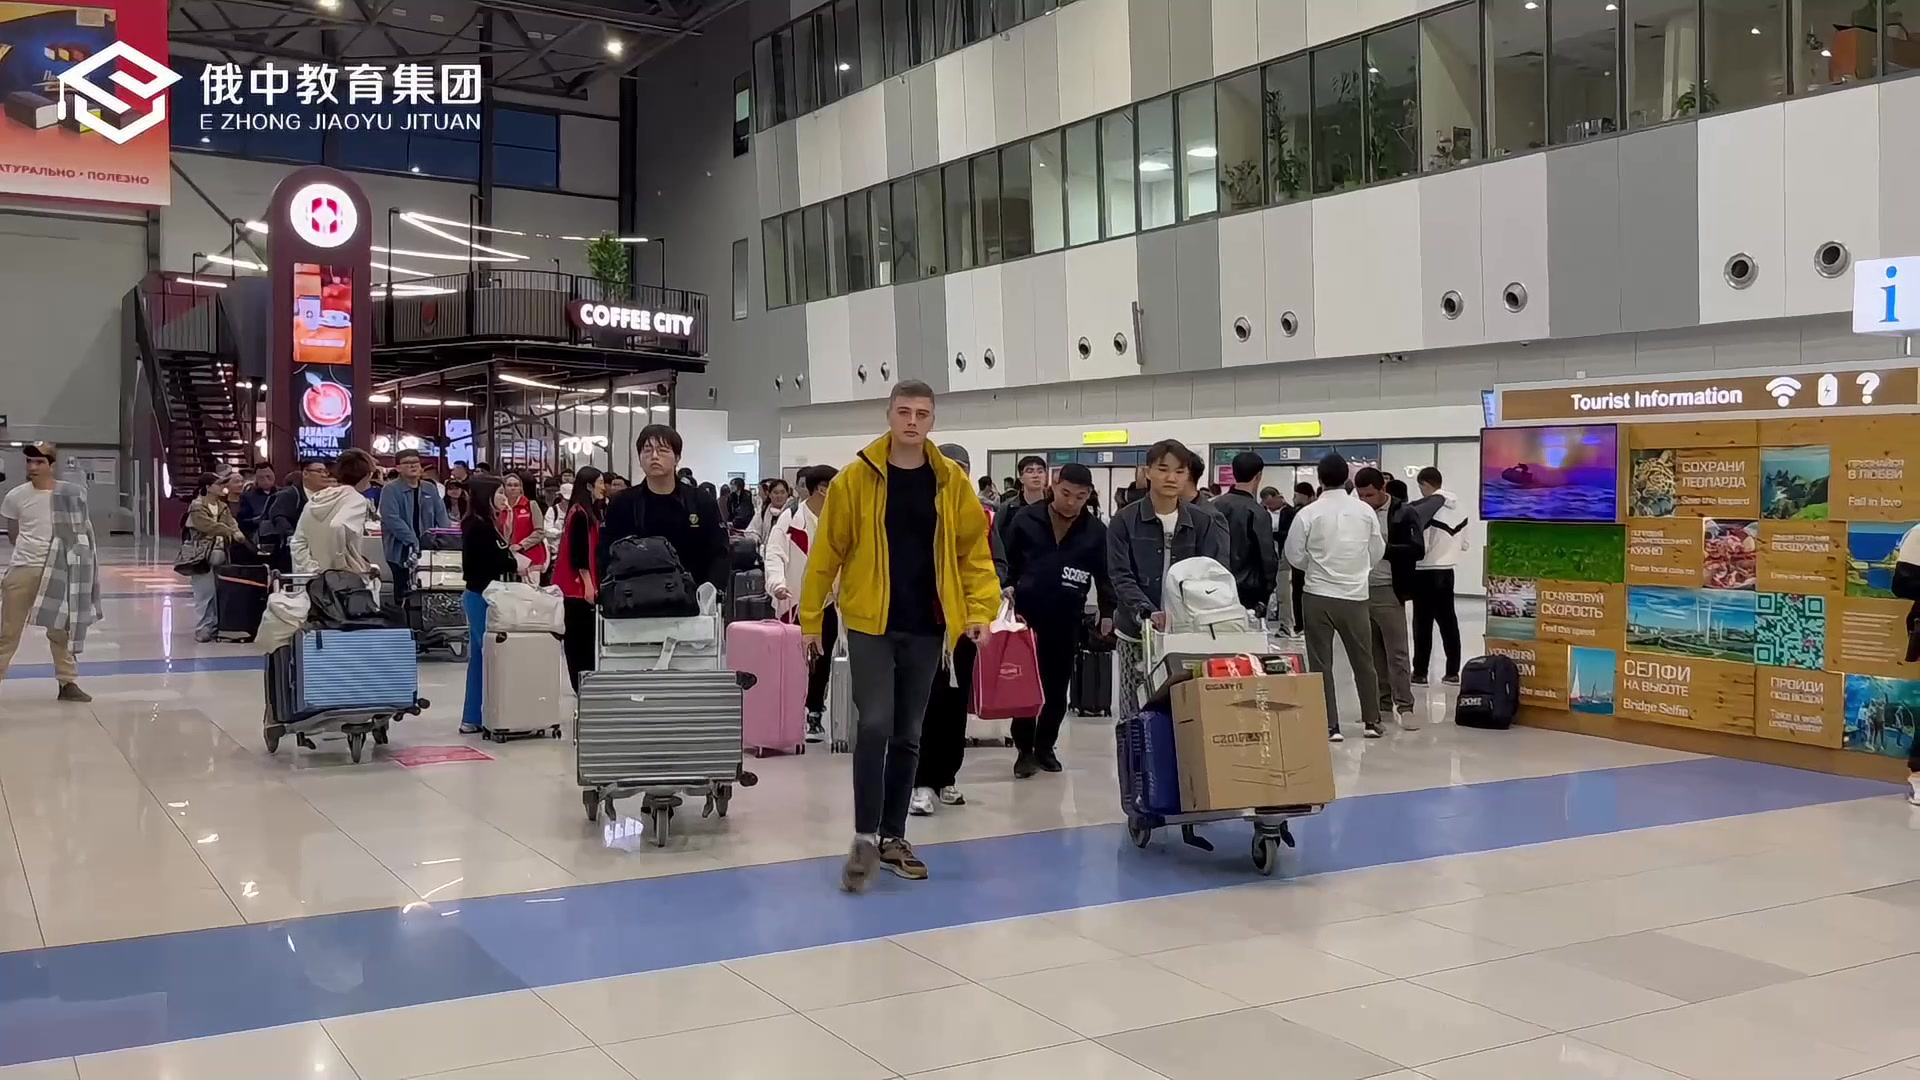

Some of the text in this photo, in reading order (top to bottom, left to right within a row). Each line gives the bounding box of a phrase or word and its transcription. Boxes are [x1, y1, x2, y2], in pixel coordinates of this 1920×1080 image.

[87, 170, 150, 185] ПОЛЕЗНО
[580, 303, 694, 336] COFFEE CITY
[1571, 386, 1743, 411] Tourist Information
[1682, 461, 1745, 473] СОХРАНИ
[1682, 476, 1747, 488] ЛЕОПАРДА
[1541, 602, 1605, 619] СКОРОСТЬ
[1624, 659, 1692, 683] СЕЛФИ
[1623, 678, 1690, 698] НА ВЫСОТЕ
[1623, 698, 1659, 714] Bridge
